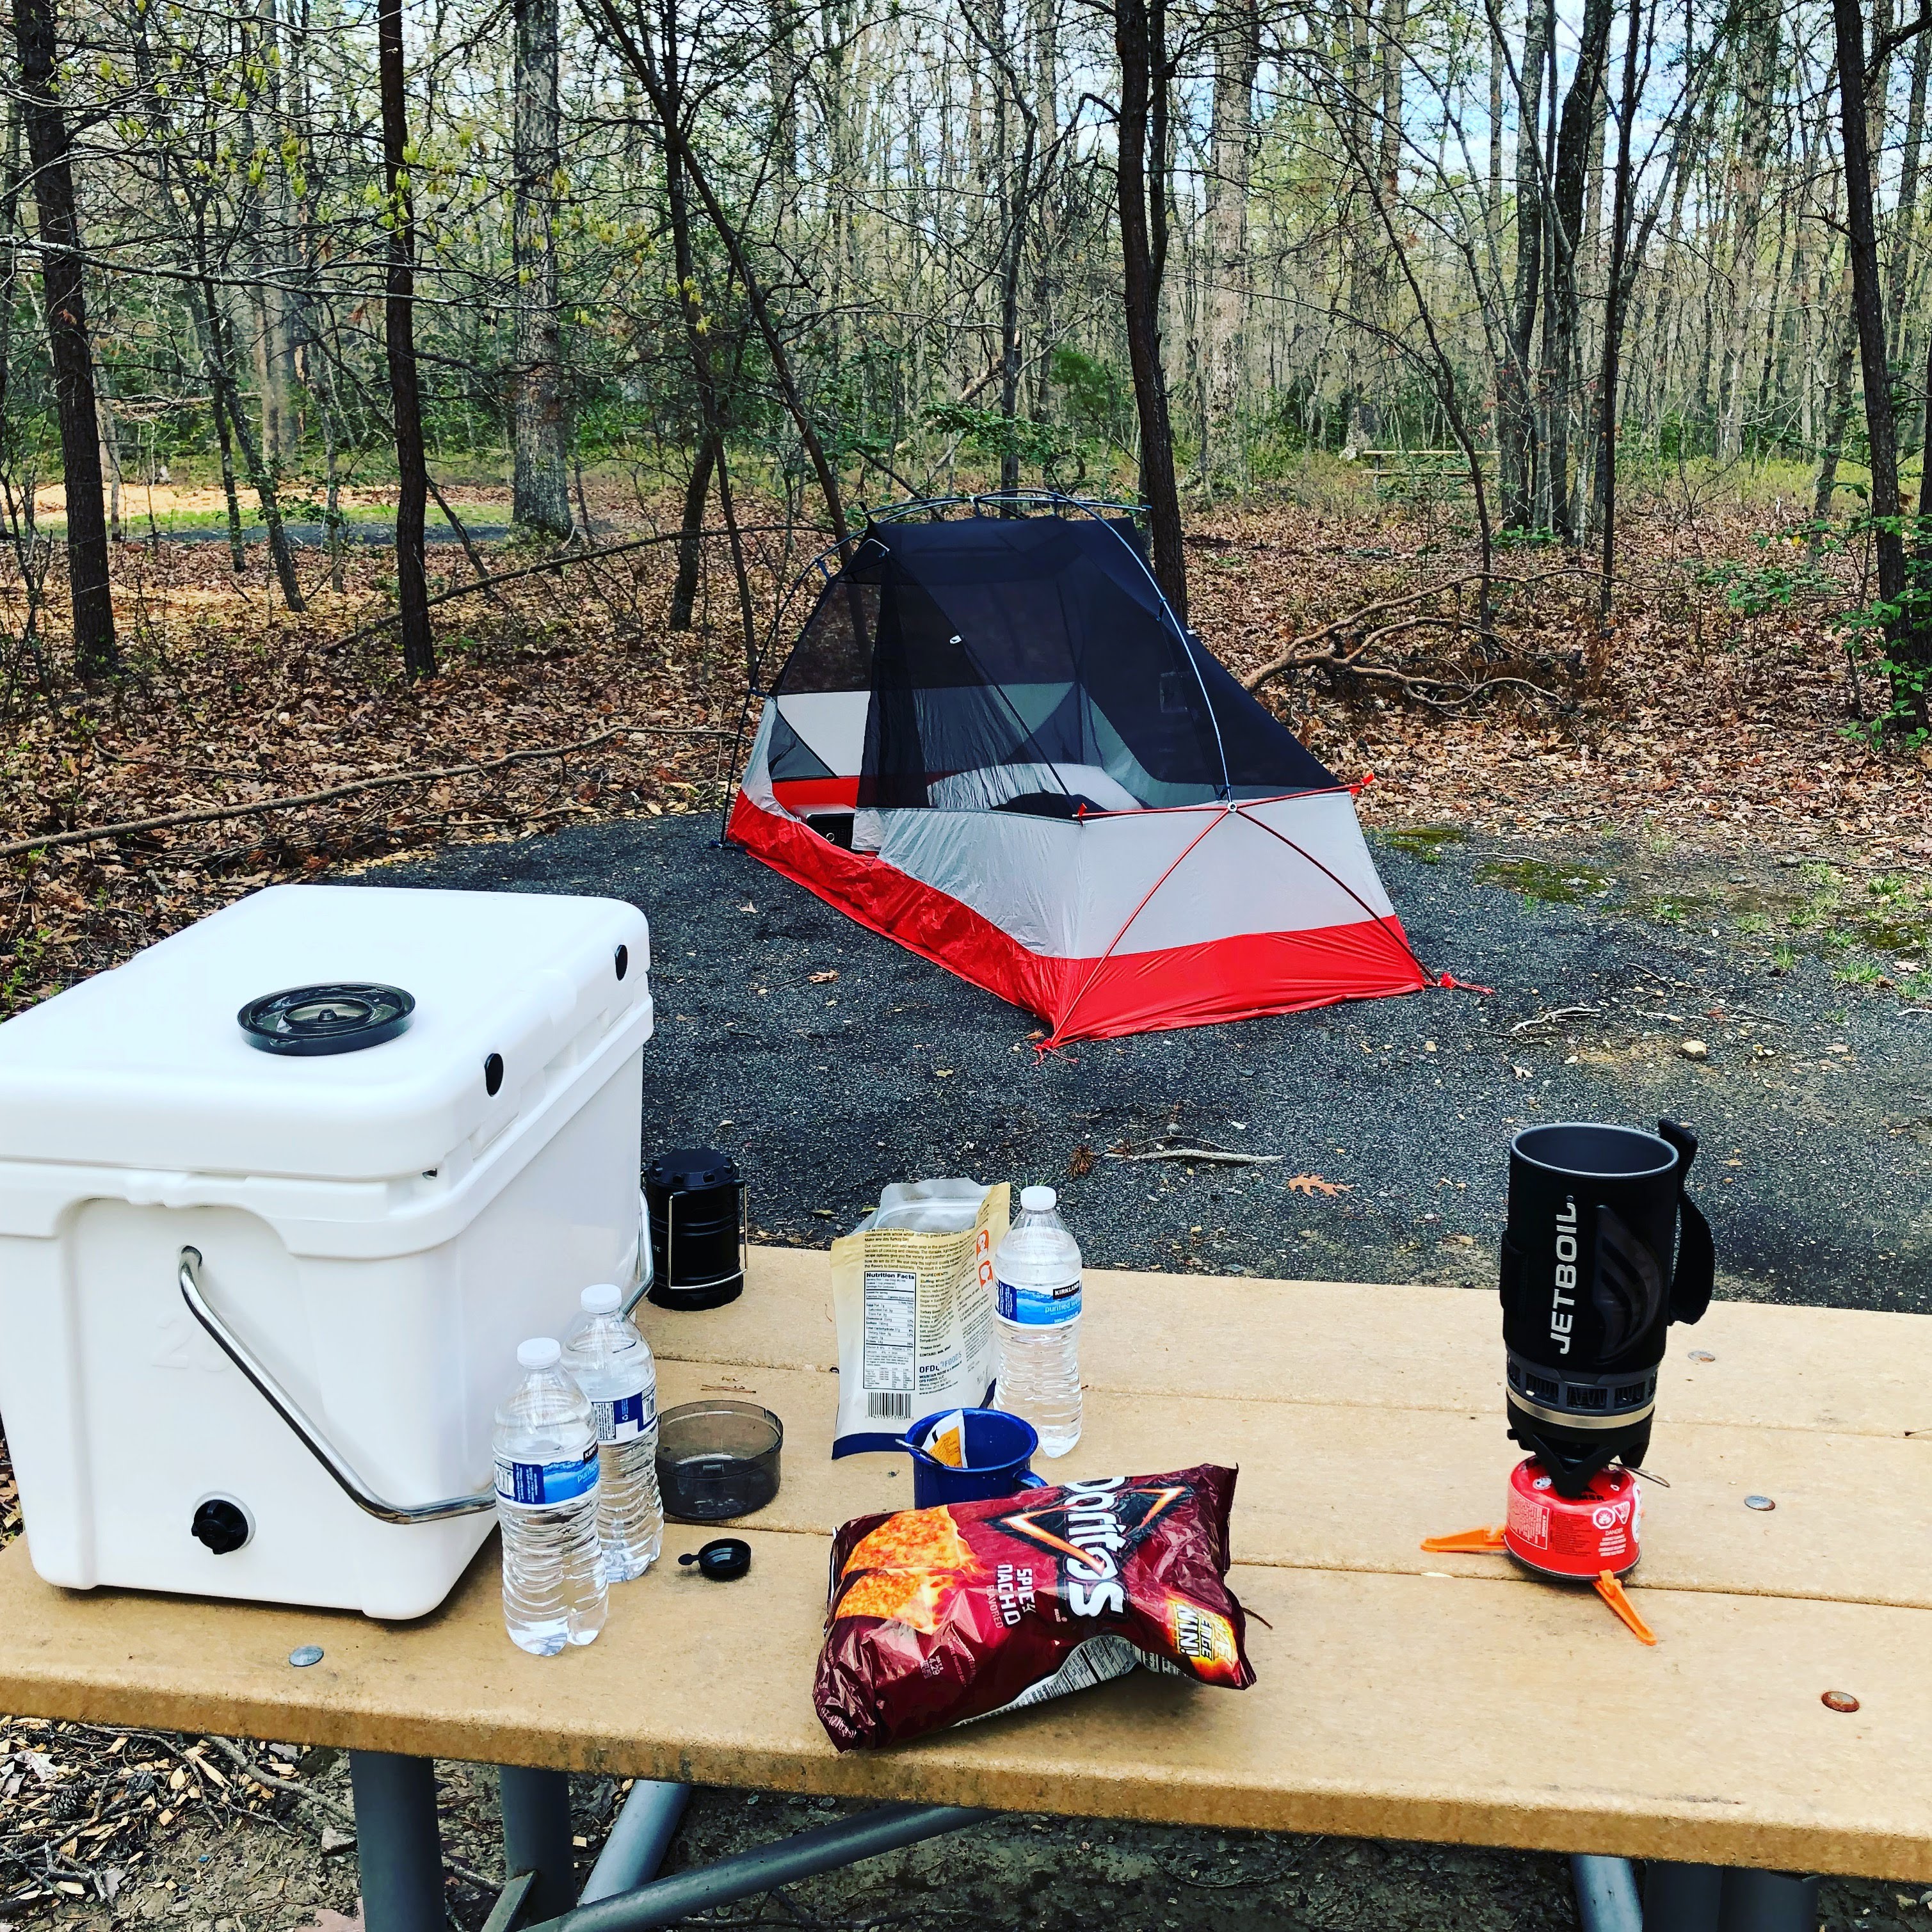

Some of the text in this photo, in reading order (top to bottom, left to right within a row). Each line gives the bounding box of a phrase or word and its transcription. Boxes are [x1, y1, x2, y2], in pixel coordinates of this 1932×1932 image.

[1054, 1282, 1079, 1296] KIRKLAND
[1550, 1202, 1577, 1355] JETBOIL
[1045, 1302, 1070, 1314] purified
[945, 1351, 962, 1367] FOODS
[986, 1584, 1004, 1629] FLAVORED
[997, 1564, 1021, 1625] NACHO
